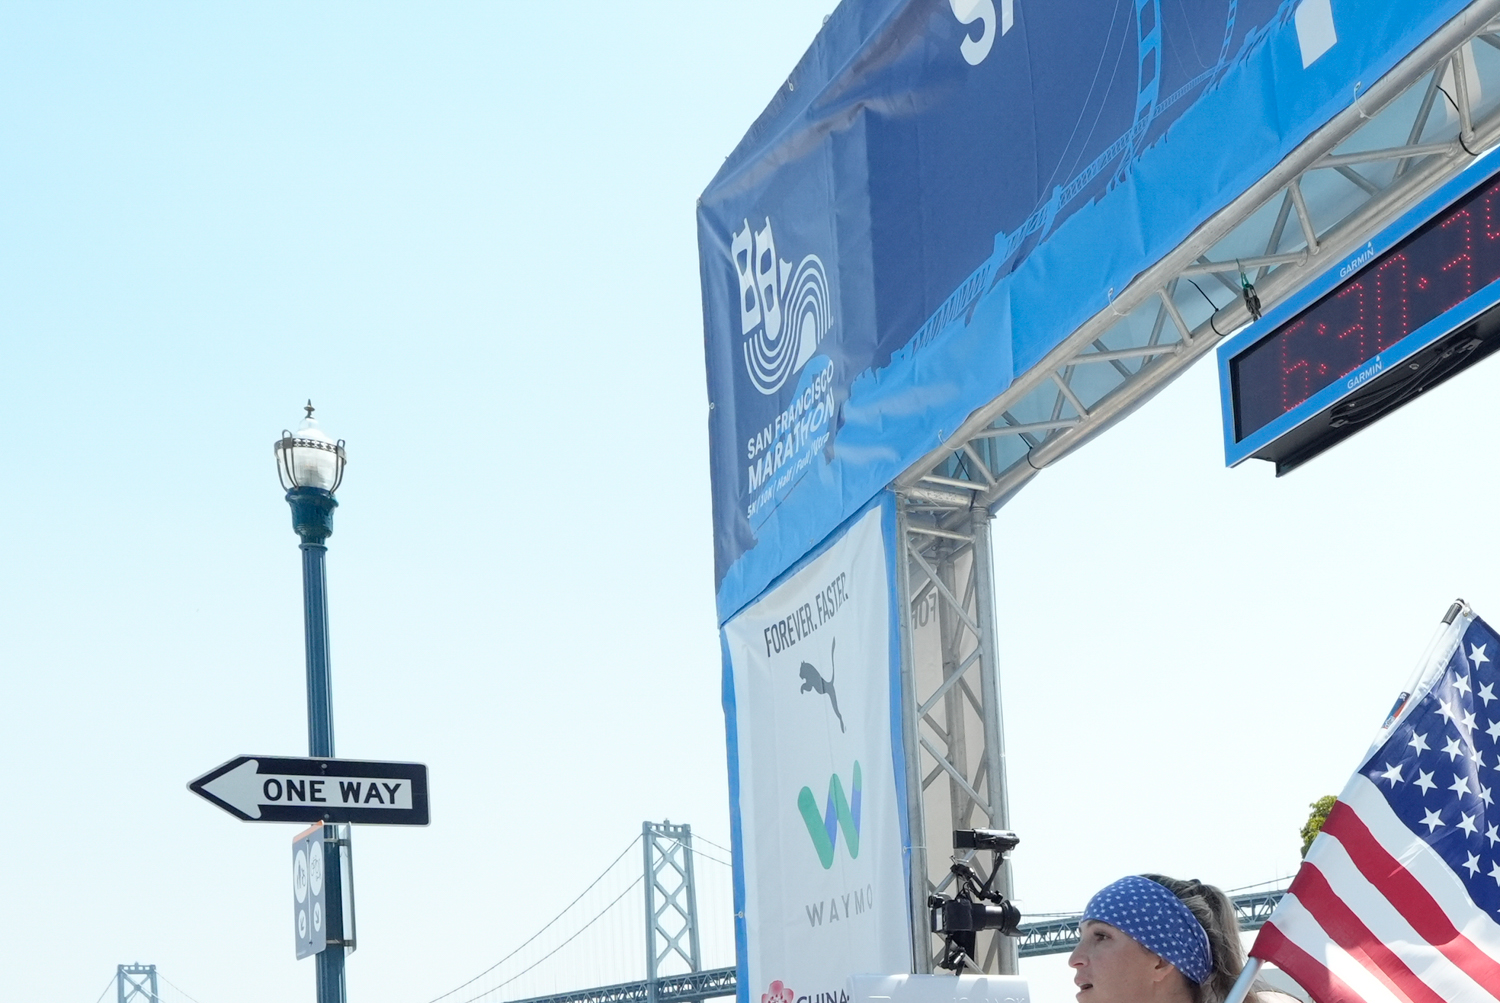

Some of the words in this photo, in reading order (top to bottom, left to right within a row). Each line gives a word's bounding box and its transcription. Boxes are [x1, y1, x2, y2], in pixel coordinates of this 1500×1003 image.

[1340, 247, 1374, 278] GARMIN
[1347, 361, 1382, 389] GARMIN
[747, 424, 772, 459] SAN
[775, 359, 834, 437] FRANCISCO
[748, 387, 835, 494] MARATHON
[764, 602, 817, 658] FOREVER.
[815, 571, 849, 626] FASTER.
[263, 779, 326, 802] ONE
[339, 781, 402, 804] WAY
[805, 883, 873, 927] WAYMO
